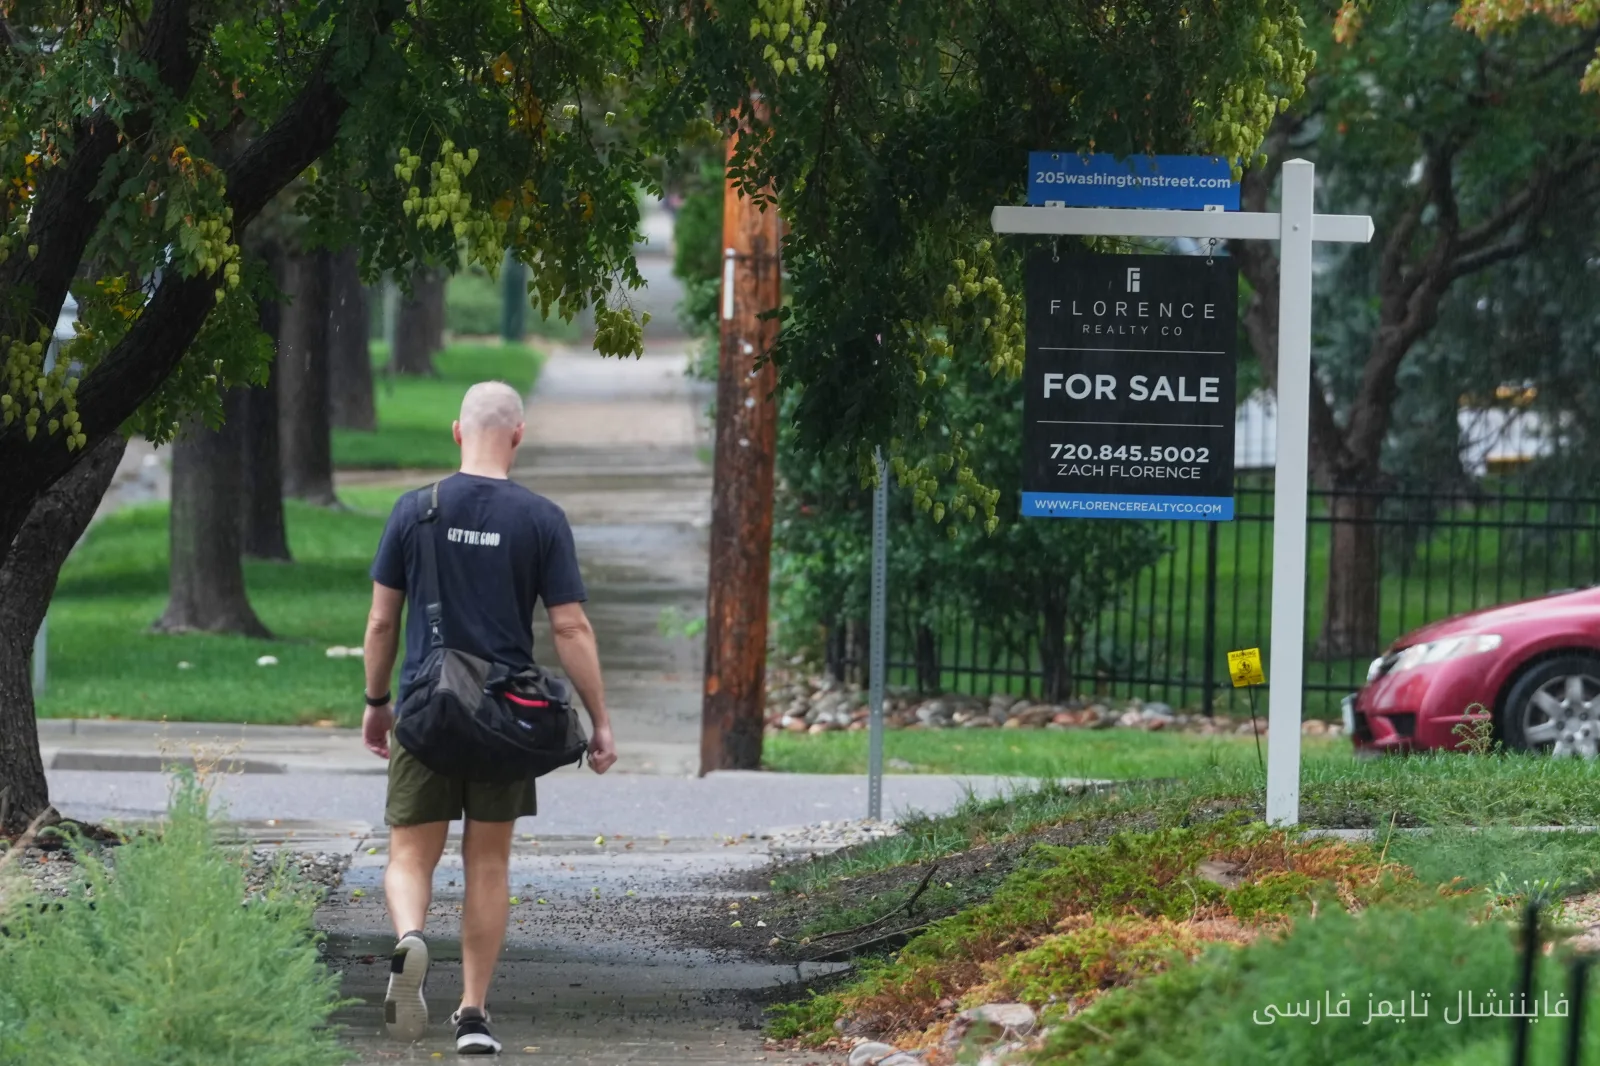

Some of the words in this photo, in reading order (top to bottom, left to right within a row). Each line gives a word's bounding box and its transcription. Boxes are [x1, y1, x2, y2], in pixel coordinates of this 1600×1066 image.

[1050, 300, 1215, 319] FLORENCE
[1082, 324, 1149, 335] REALTY
[1161, 326, 1183, 336] CO
[1043, 373, 1117, 400] FOR
[1128, 375, 1220, 403] SALE
[1050, 443, 1209, 463] 720.845.5002
[1057, 464, 1104, 477] ZACH
[1109, 465, 1201, 479] FLORENCE
[1034, 499, 1222, 514] WWW.FLORENCEREALTYCO.COM
[447, 527, 463, 542] GET
[463, 530, 480, 545] THE
[480, 531, 501, 546] GOOD
